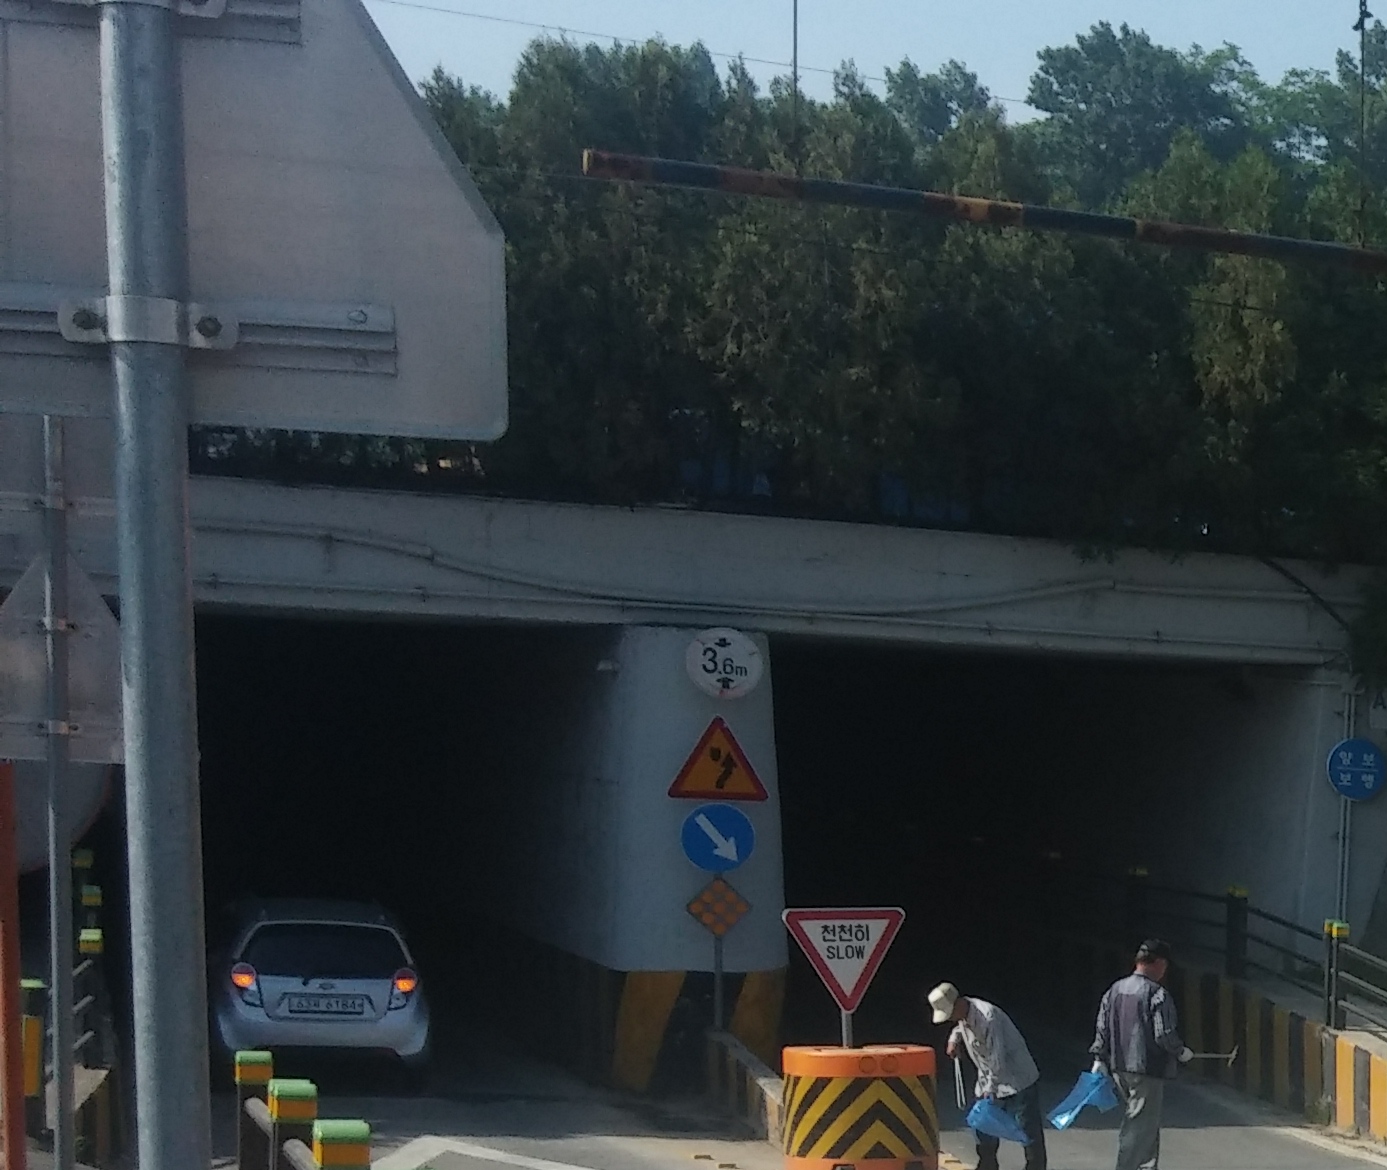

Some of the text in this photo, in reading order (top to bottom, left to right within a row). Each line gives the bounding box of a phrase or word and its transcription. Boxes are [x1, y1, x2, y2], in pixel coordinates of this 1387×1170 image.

[701, 647, 748, 677] 3.6m
[820, 923, 870, 943] 천천히
[826, 943, 866, 961] SLOW
